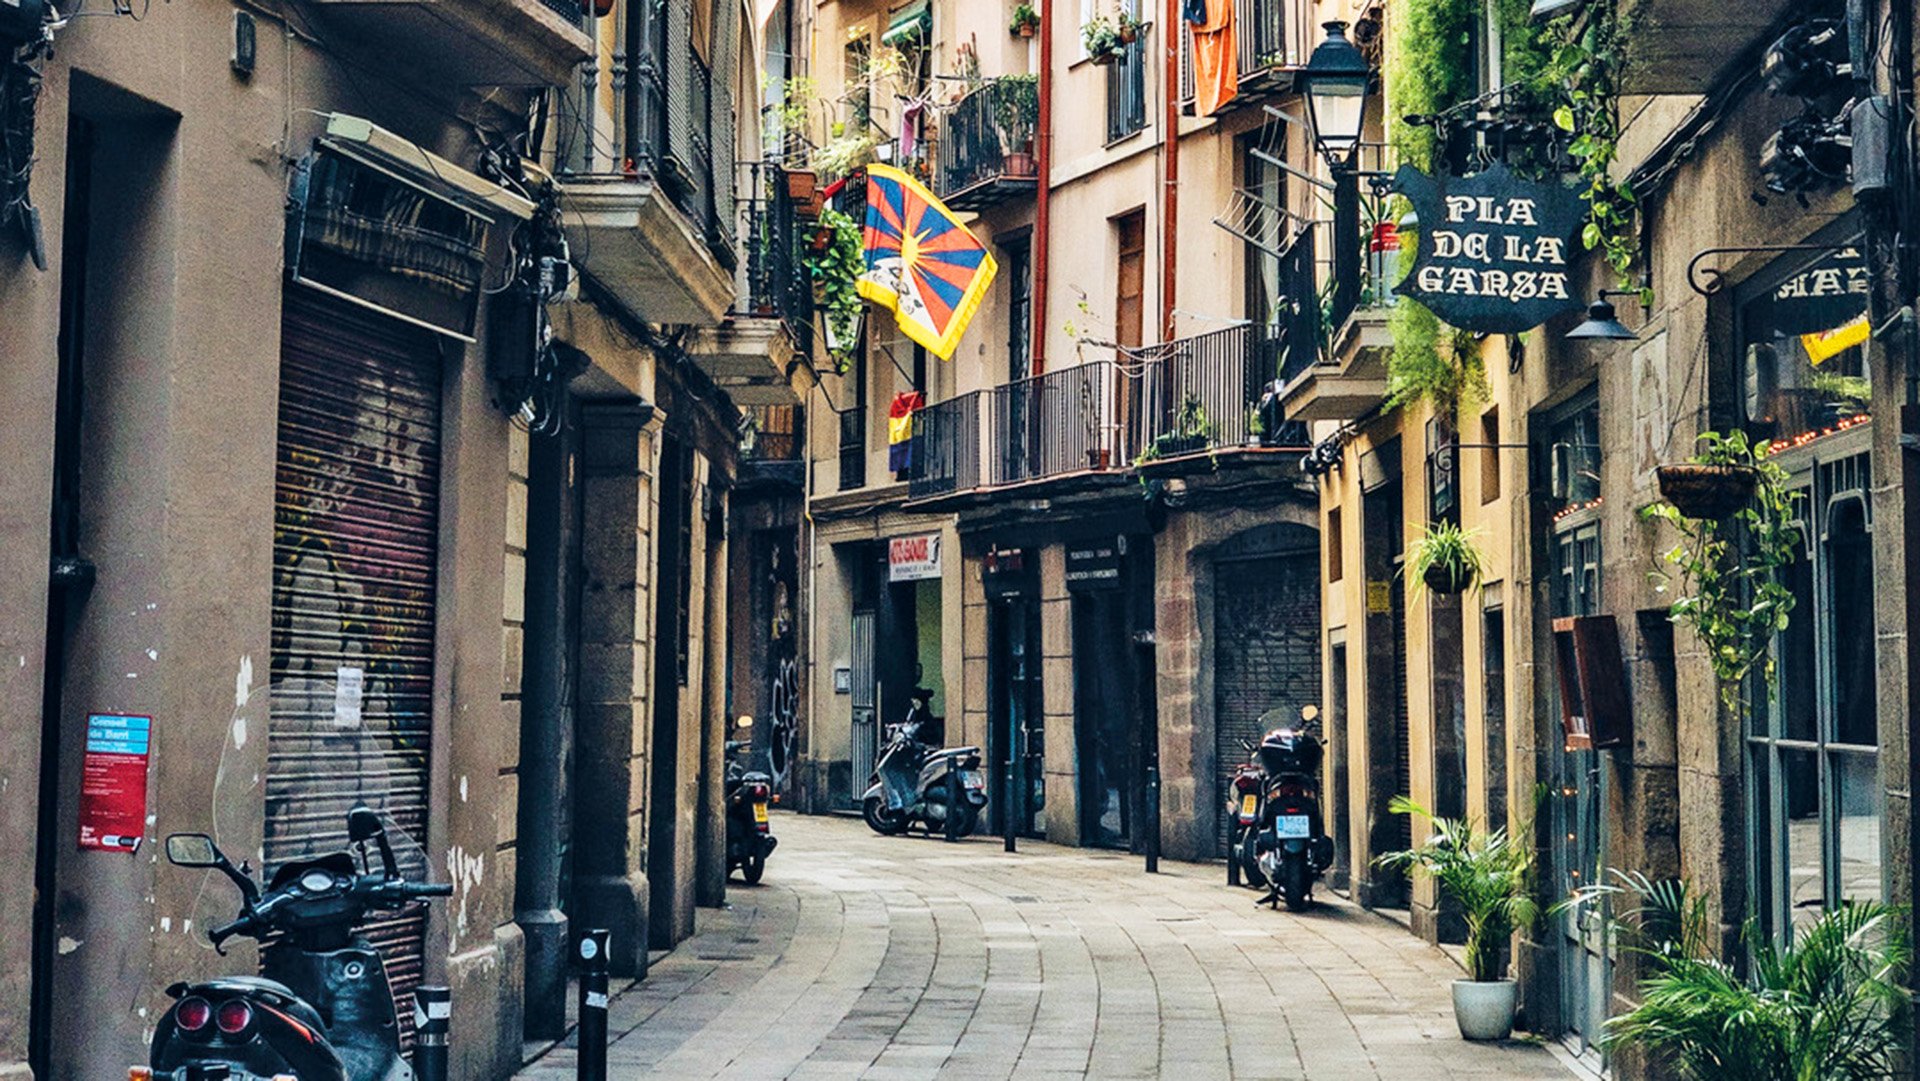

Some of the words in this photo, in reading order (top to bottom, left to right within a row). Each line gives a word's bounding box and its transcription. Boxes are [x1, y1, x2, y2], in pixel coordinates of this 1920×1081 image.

[1445, 195, 1538, 226] PLA
[1432, 230, 1492, 264] DE
[1503, 235, 1566, 264] LA
[89, 729, 102, 739] de
